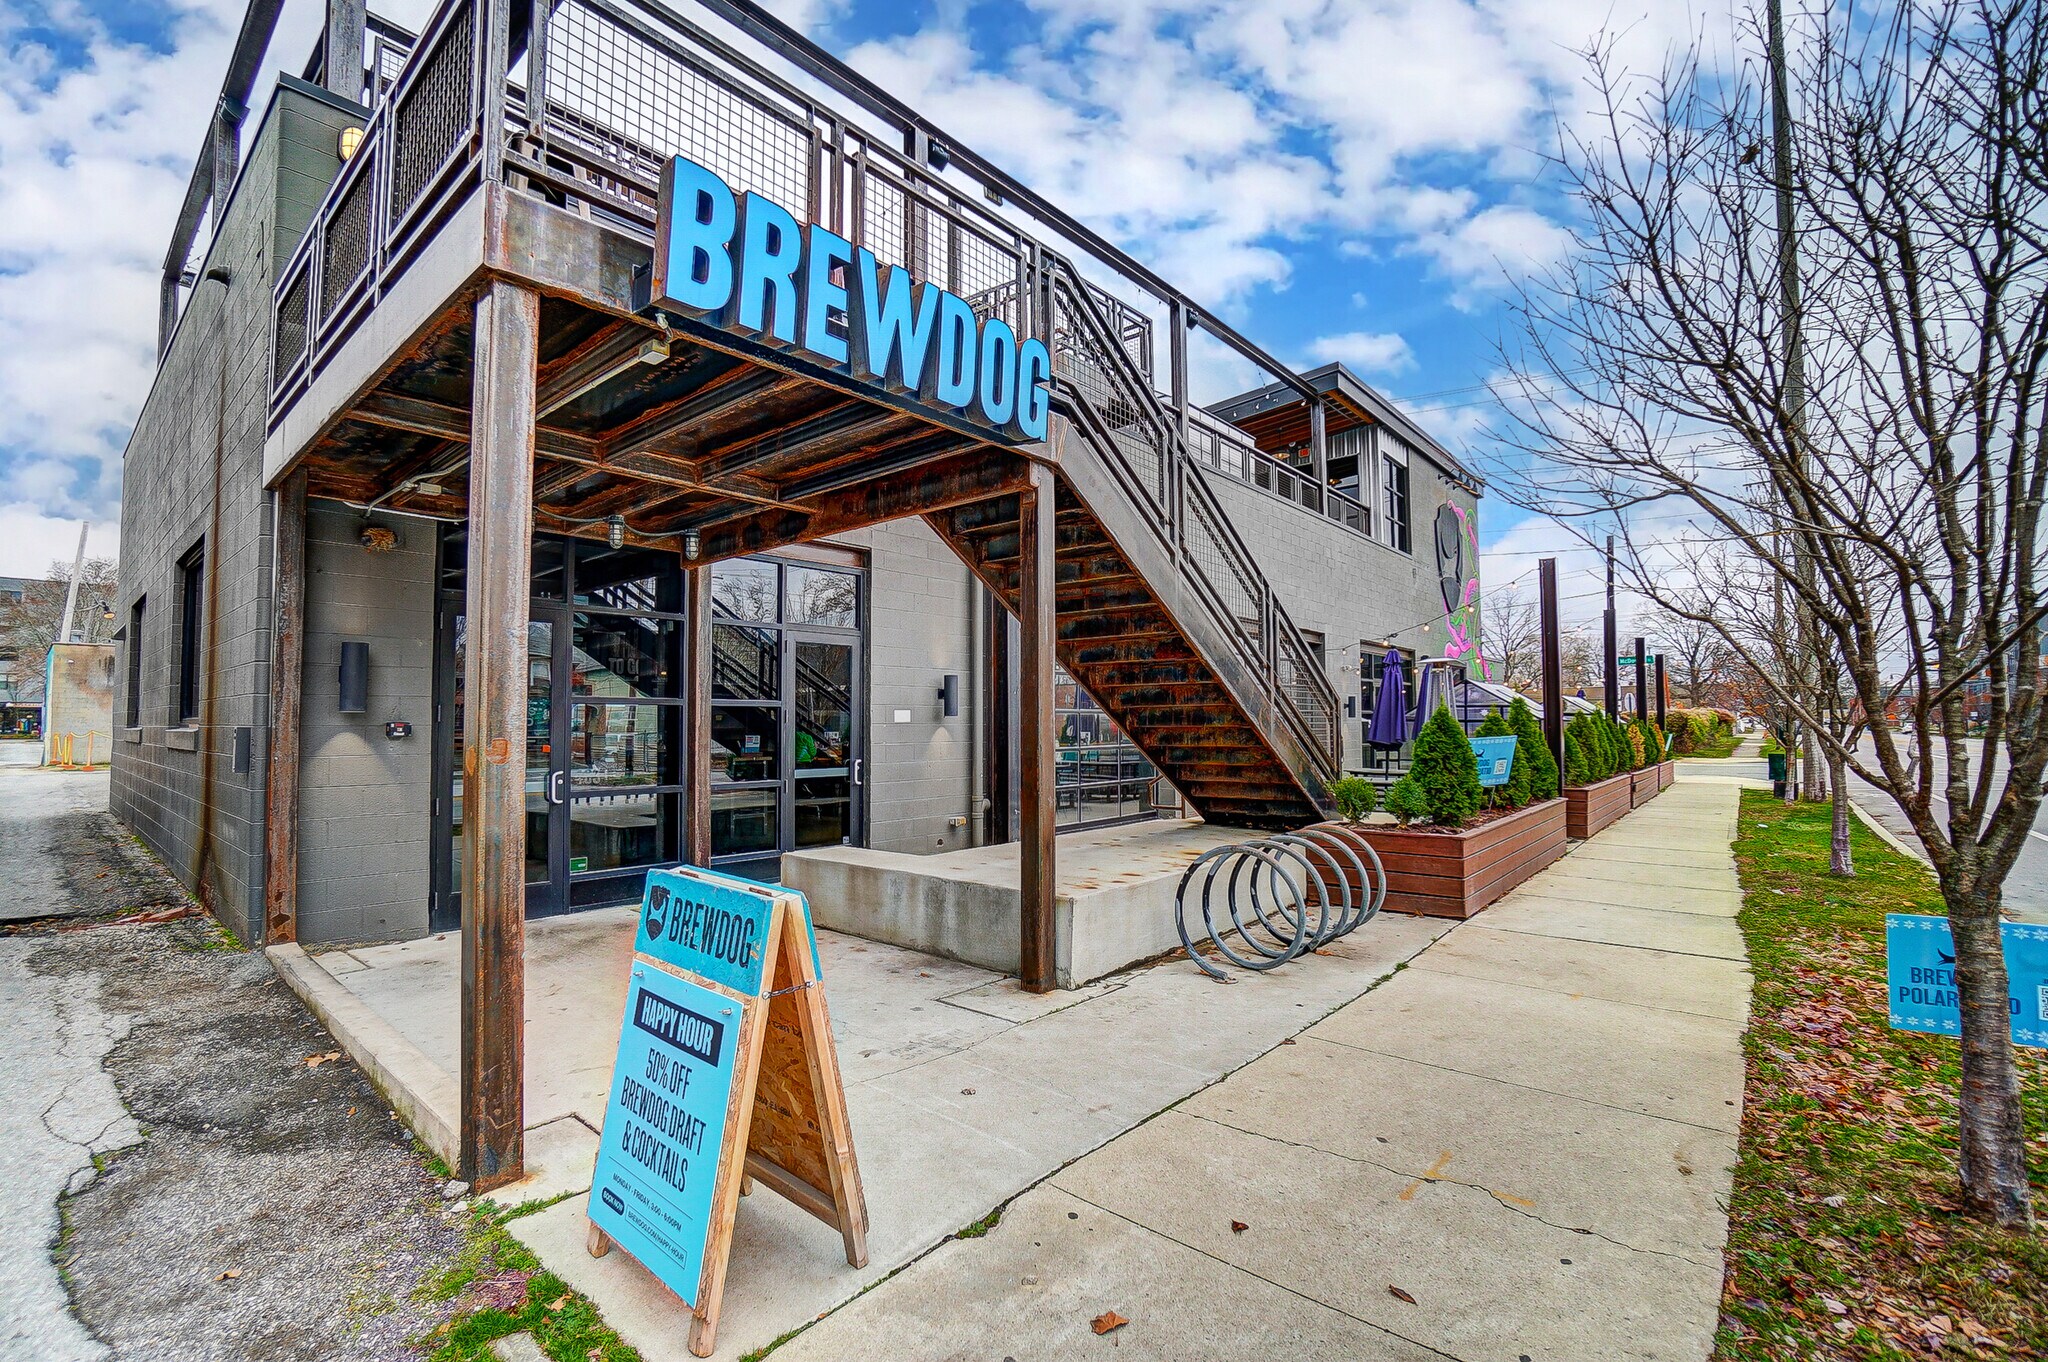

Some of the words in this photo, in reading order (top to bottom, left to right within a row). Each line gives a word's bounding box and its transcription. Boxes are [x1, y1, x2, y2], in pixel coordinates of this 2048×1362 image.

[664, 154, 1050, 442] BREWDOG
[668, 897, 755, 969] BREWDOG
[641, 996, 679, 1038] HAPPY
[676, 1013, 714, 1056] HOUR
[1900, 986, 1959, 1008] POLAR
[645, 1047, 670, 1089] 50%
[669, 1061, 692, 1100] OFF
[620, 1075, 670, 1133] BREWDOG
[668, 1104, 707, 1156] DRAFT
[622, 1119, 632, 1153] &
[631, 1125, 688, 1193] COCKTAILS
[603, 1190, 614, 1204] BOOK
[613, 1173, 631, 1192] MONDAY
[633, 1189, 650, 1209] FRIDAY,
